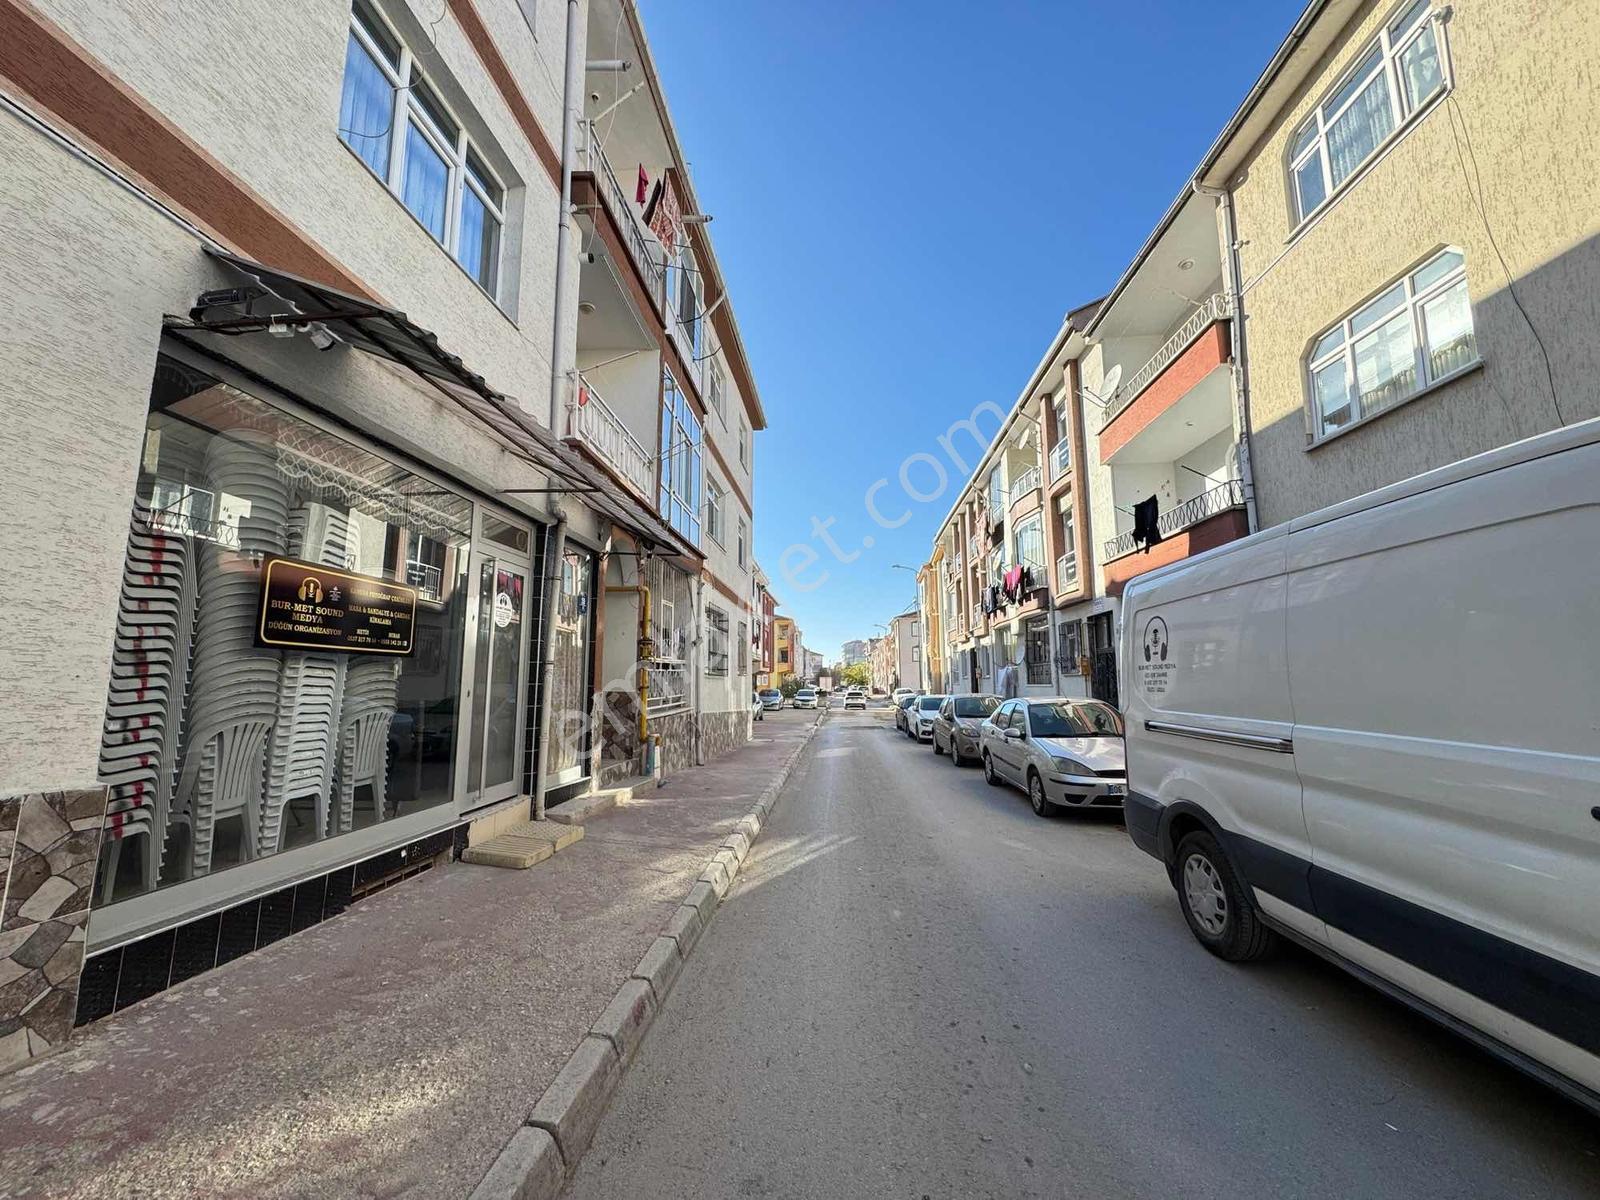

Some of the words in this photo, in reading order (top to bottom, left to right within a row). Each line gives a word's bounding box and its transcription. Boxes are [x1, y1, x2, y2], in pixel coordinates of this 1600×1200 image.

[272, 600, 314, 613] BUR-MET
[316, 607, 344, 617] SOUND
[292, 613, 323, 623] MEDYA
[268, 621, 293, 631] DÜĞÜN
[294, 625, 342, 635] ORGANİZASYON
